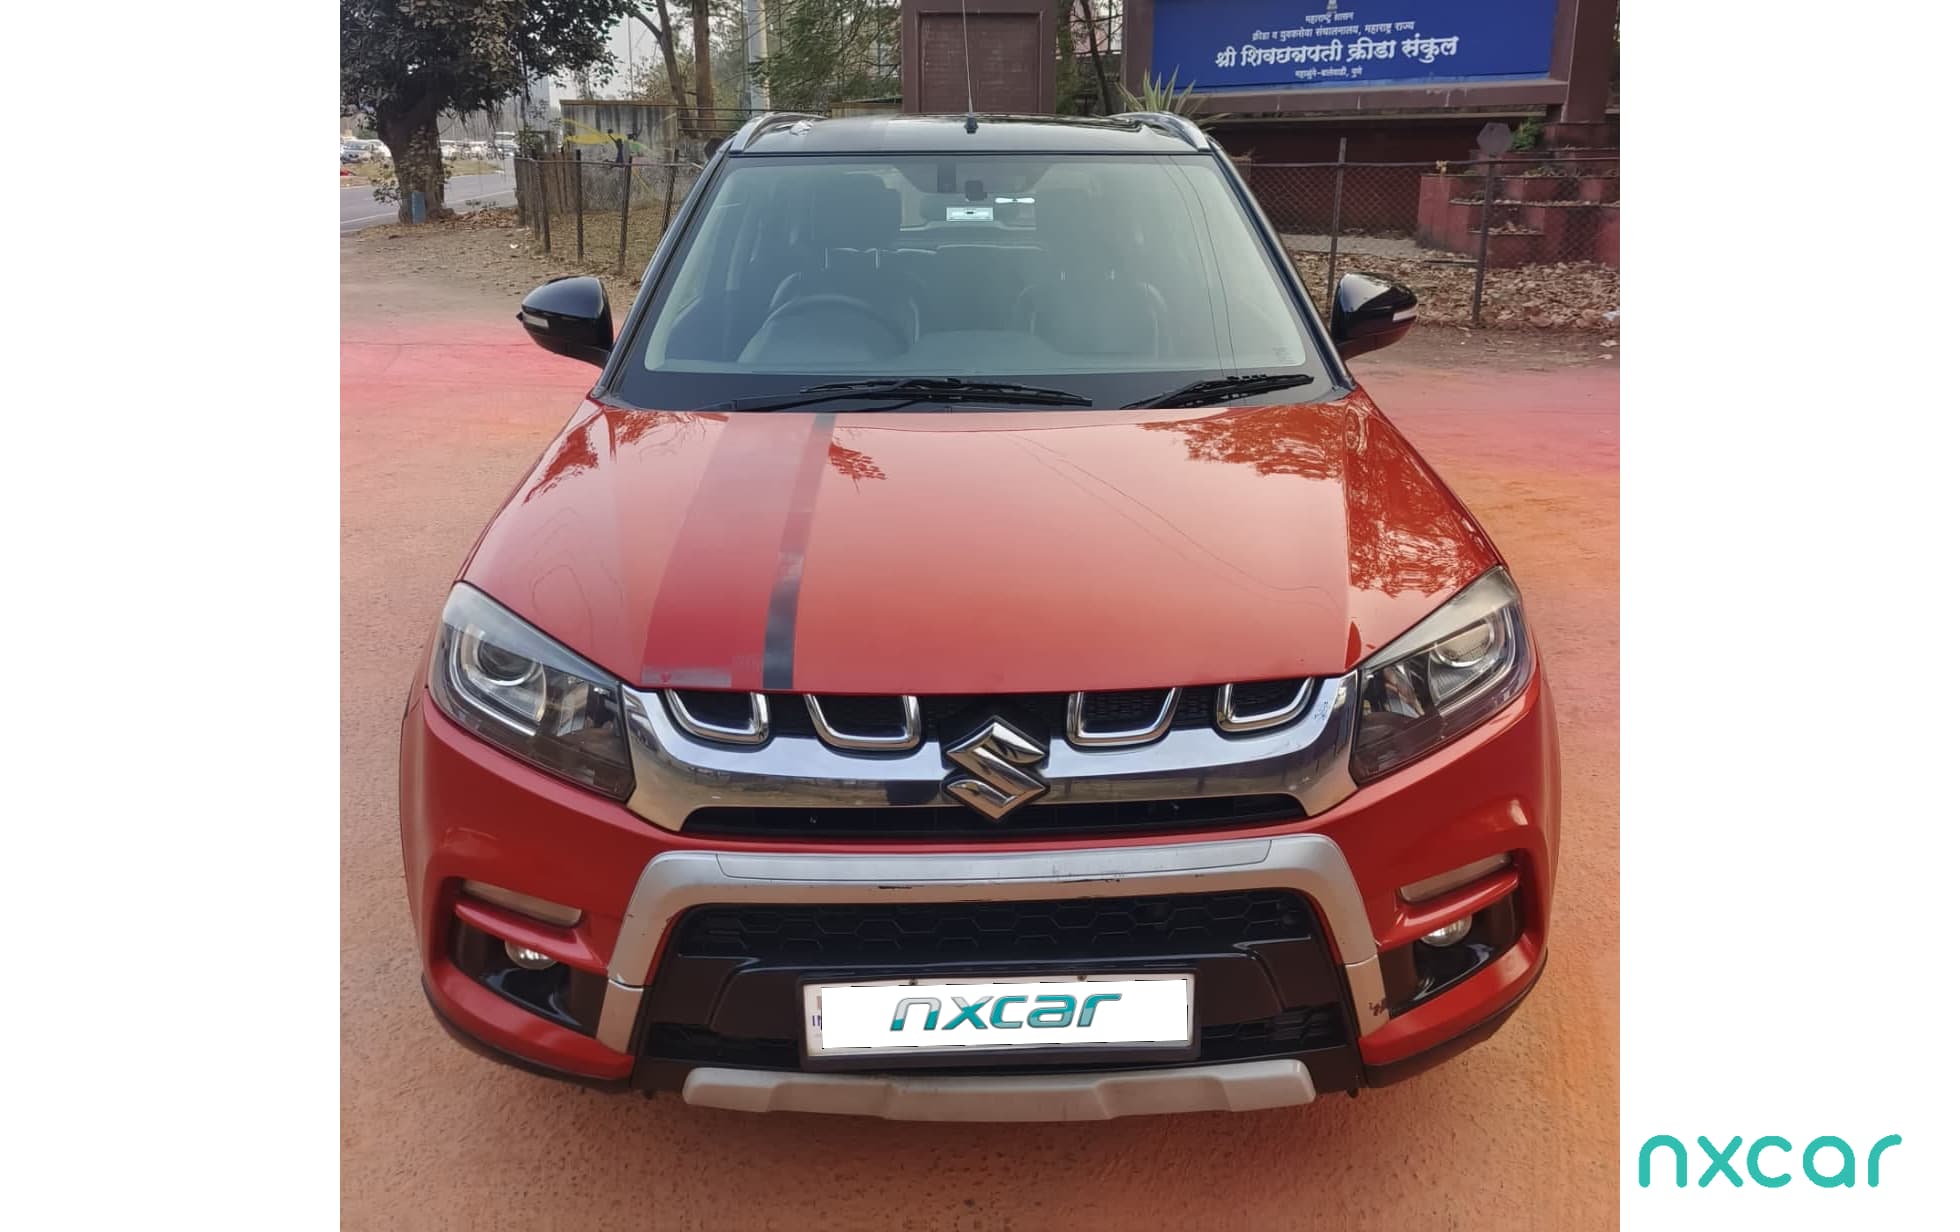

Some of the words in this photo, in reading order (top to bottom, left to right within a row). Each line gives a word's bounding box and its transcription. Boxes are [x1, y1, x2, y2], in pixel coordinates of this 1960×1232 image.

[1215, 46, 1235, 68] श्री
[1240, 38, 1343, 67] शिवछत्रपती
[1346, 37, 1397, 62] क्रीडा
[1401, 33, 1459, 63] संकुल
